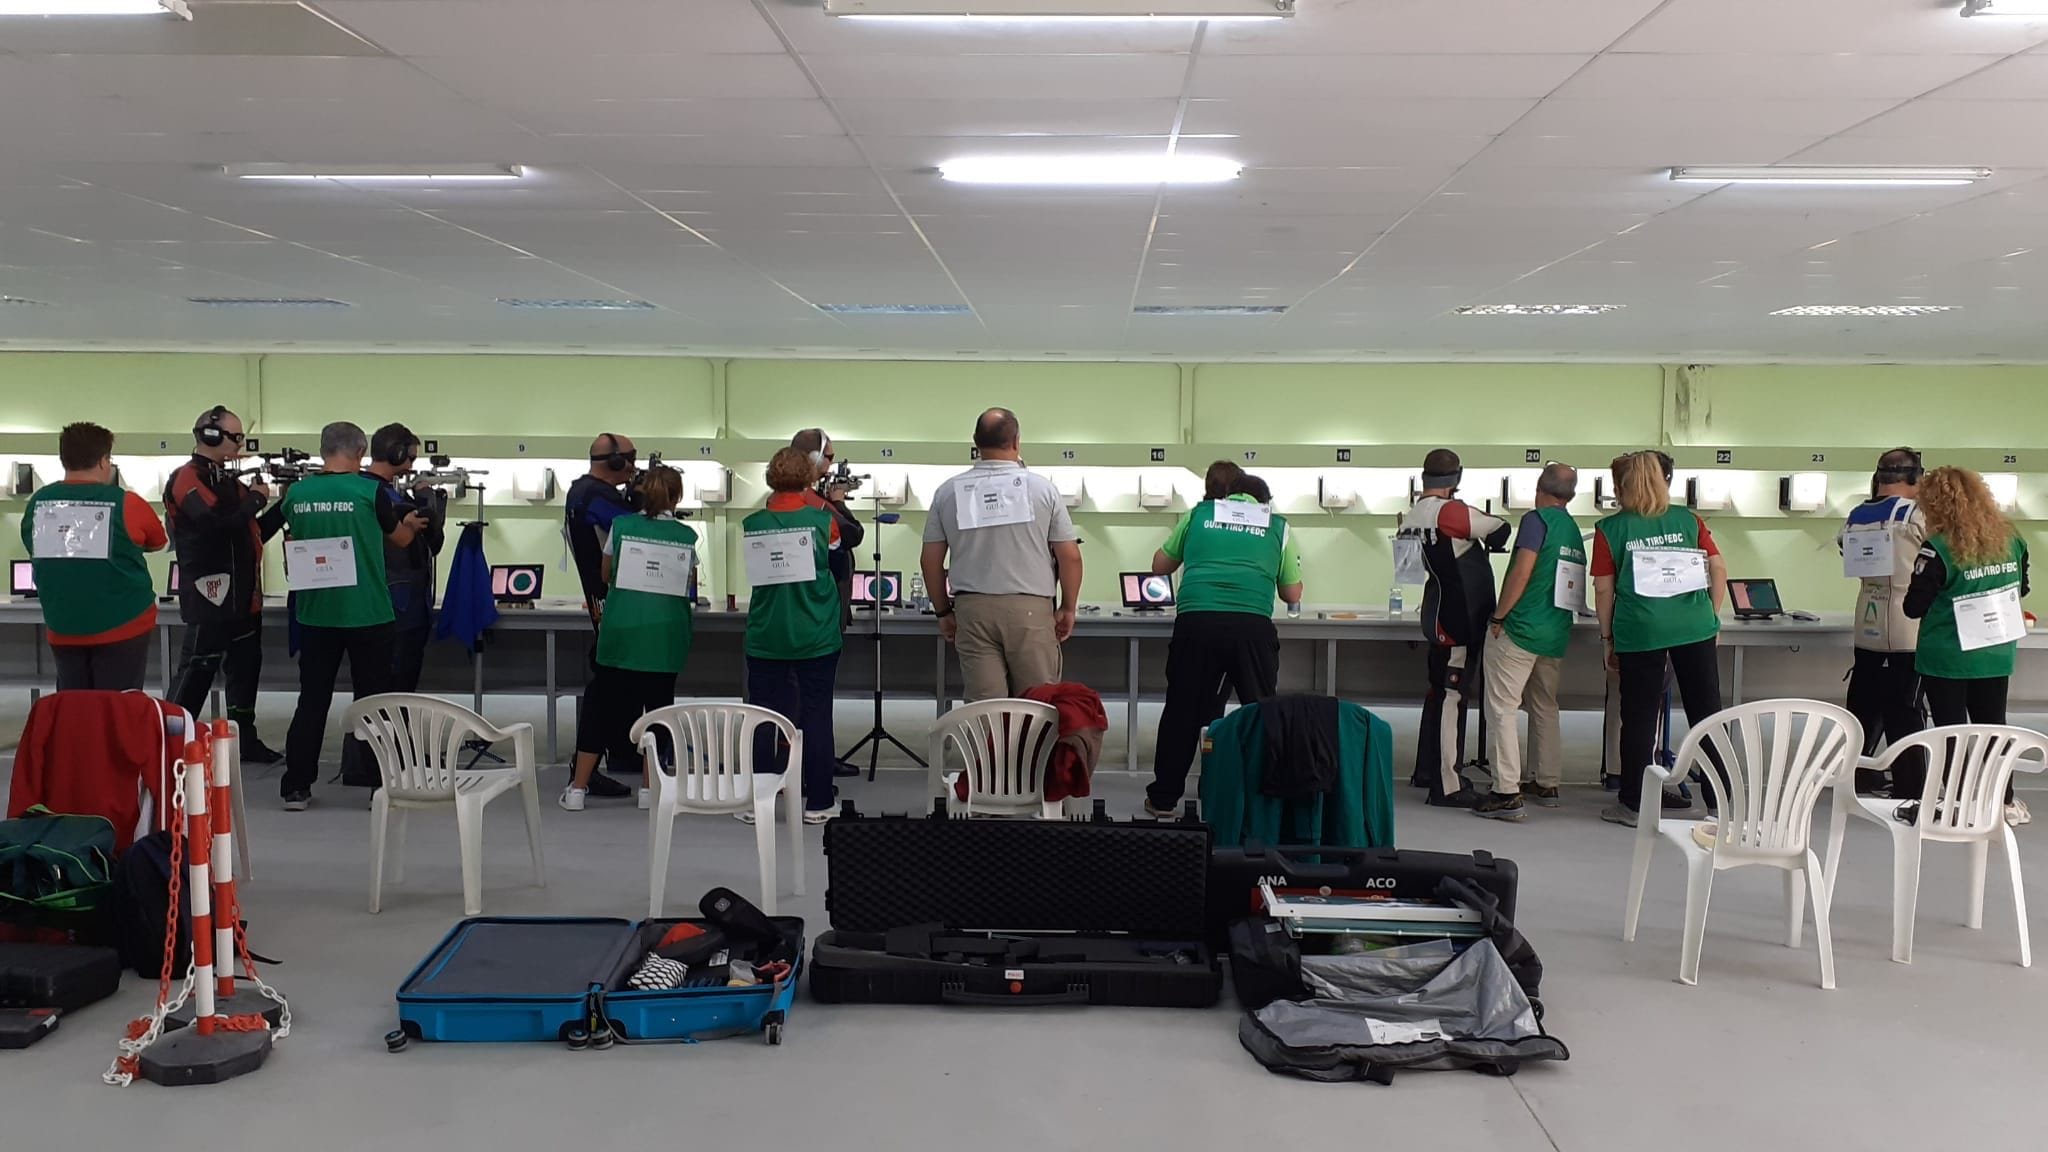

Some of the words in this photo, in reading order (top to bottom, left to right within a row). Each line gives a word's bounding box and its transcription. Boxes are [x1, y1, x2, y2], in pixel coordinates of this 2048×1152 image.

[160, 441, 167, 450] 5
[428, 442, 435, 451] 8
[518, 444, 525, 453] 9
[699, 447, 711, 455] 11
[881, 449, 893, 457] 13
[1062, 451, 1074, 459] 15
[1152, 451, 1164, 459] 16
[1244, 451, 1256, 460] 17
[1337, 451, 1349, 460] 18
[1527, 452, 1540, 460] 20
[1718, 452, 1730, 461] 22
[1812, 454, 1824, 462] 23
[2004, 456, 2016, 464] 25
[293, 501, 312, 514] GUÍA
[313, 502, 332, 513] TIRO
[333, 502, 354, 512] FEDC
[1245, 526, 1266, 537] FEDC
[1626, 538, 1645, 551] GUÍA
[1645, 535, 1664, 547] TIRO
[1664, 533, 1684, 545] FEDC
[1964, 567, 1984, 580] GUÍA
[1257, 875, 1287, 887] ANA
[1365, 877, 1397, 889] ACO
